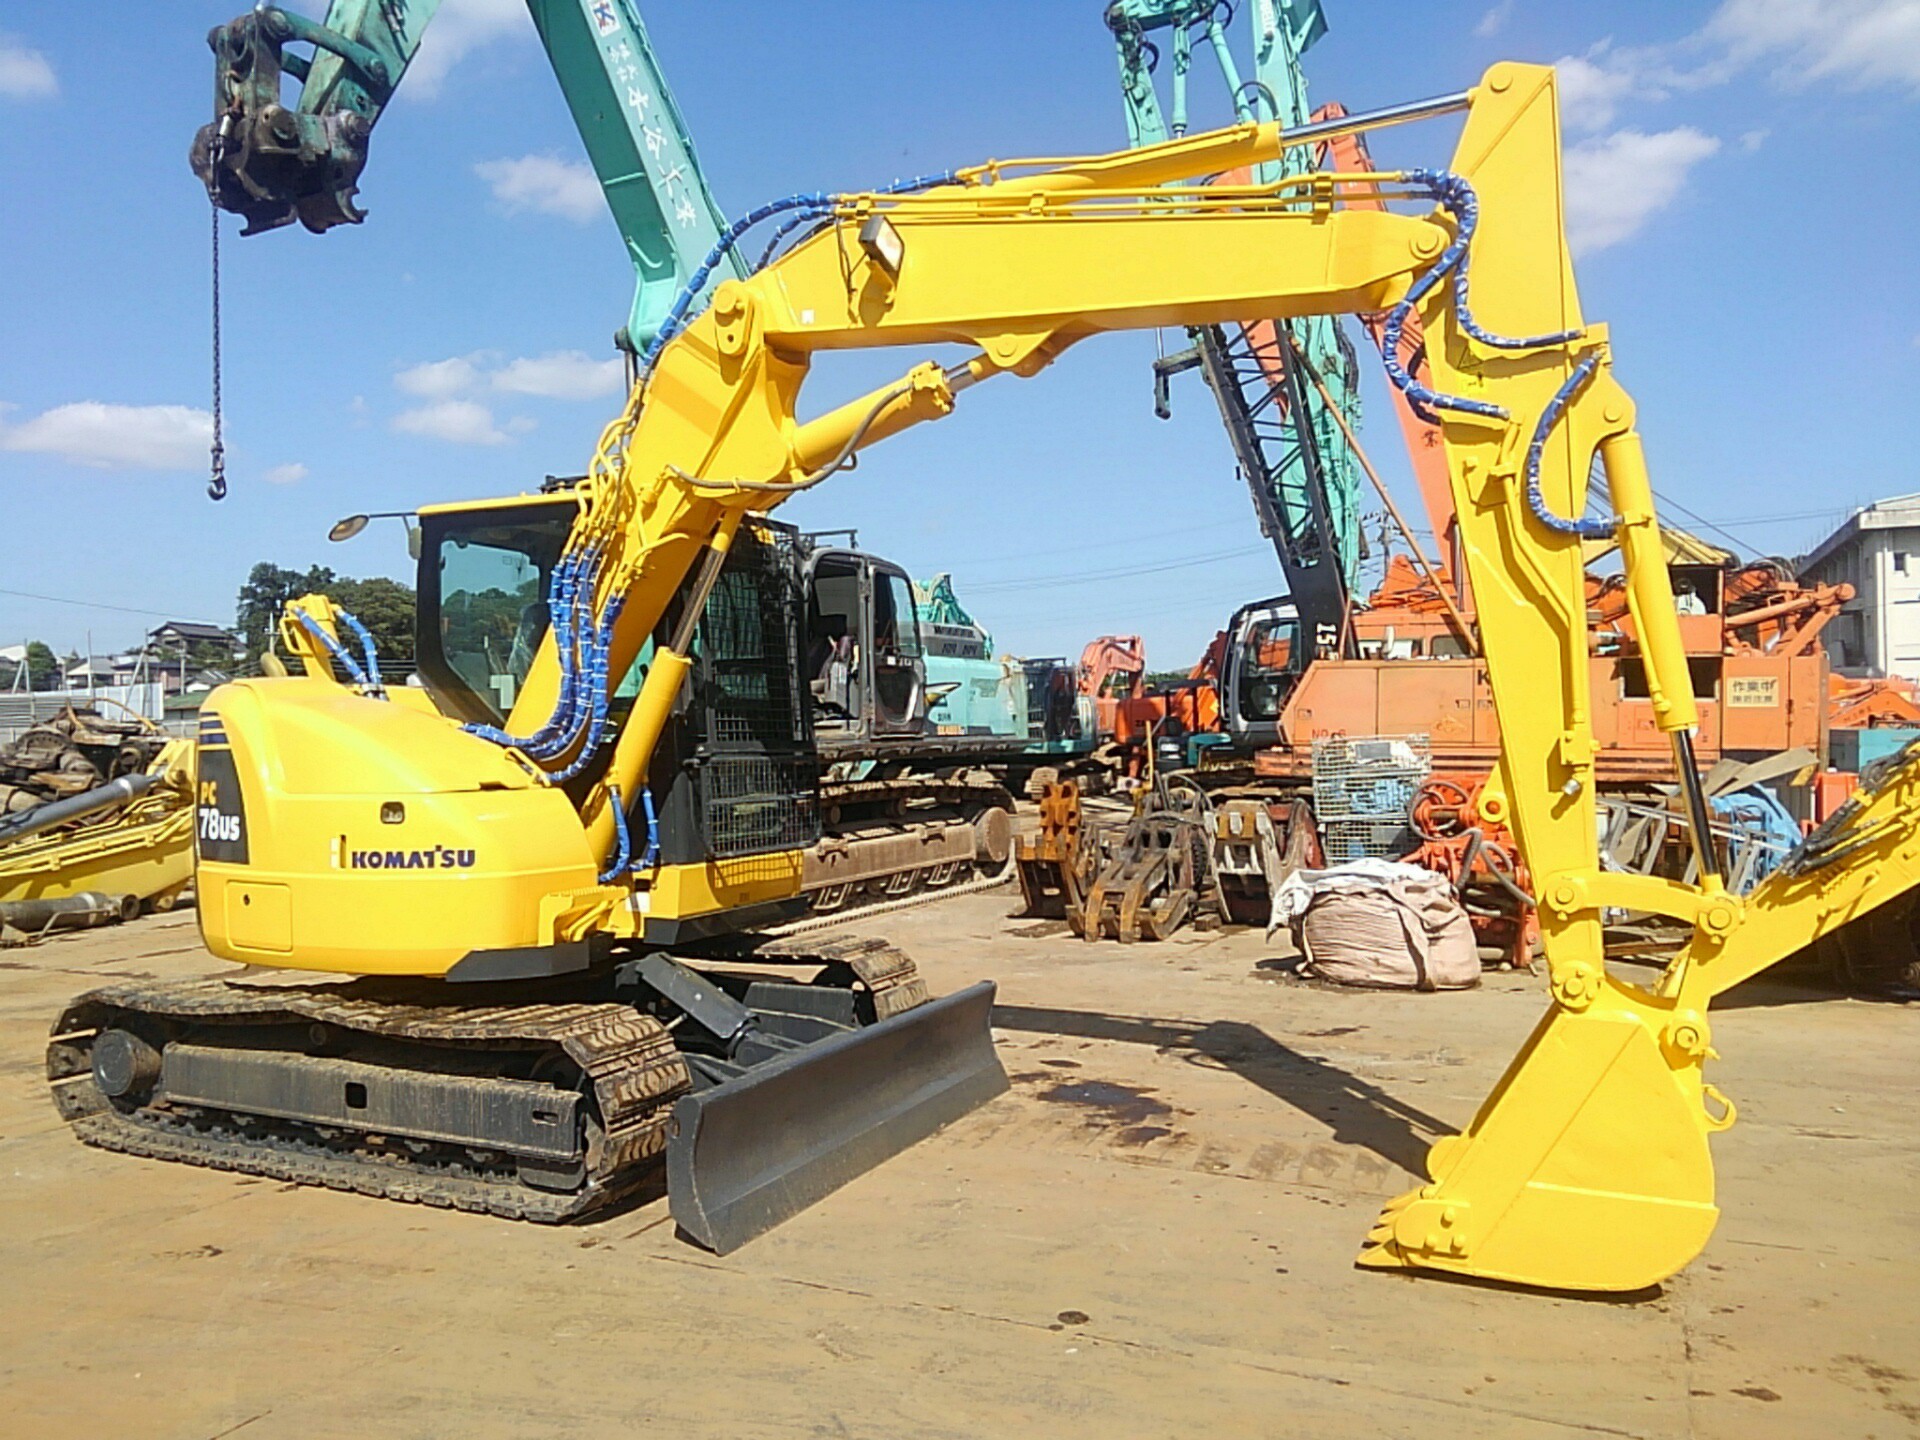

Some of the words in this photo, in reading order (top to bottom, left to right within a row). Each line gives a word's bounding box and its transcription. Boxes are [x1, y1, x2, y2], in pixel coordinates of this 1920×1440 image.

[201, 781, 217, 805] PC
[199, 808, 240, 841] 78US
[351, 844, 476, 869] KOMATSU
